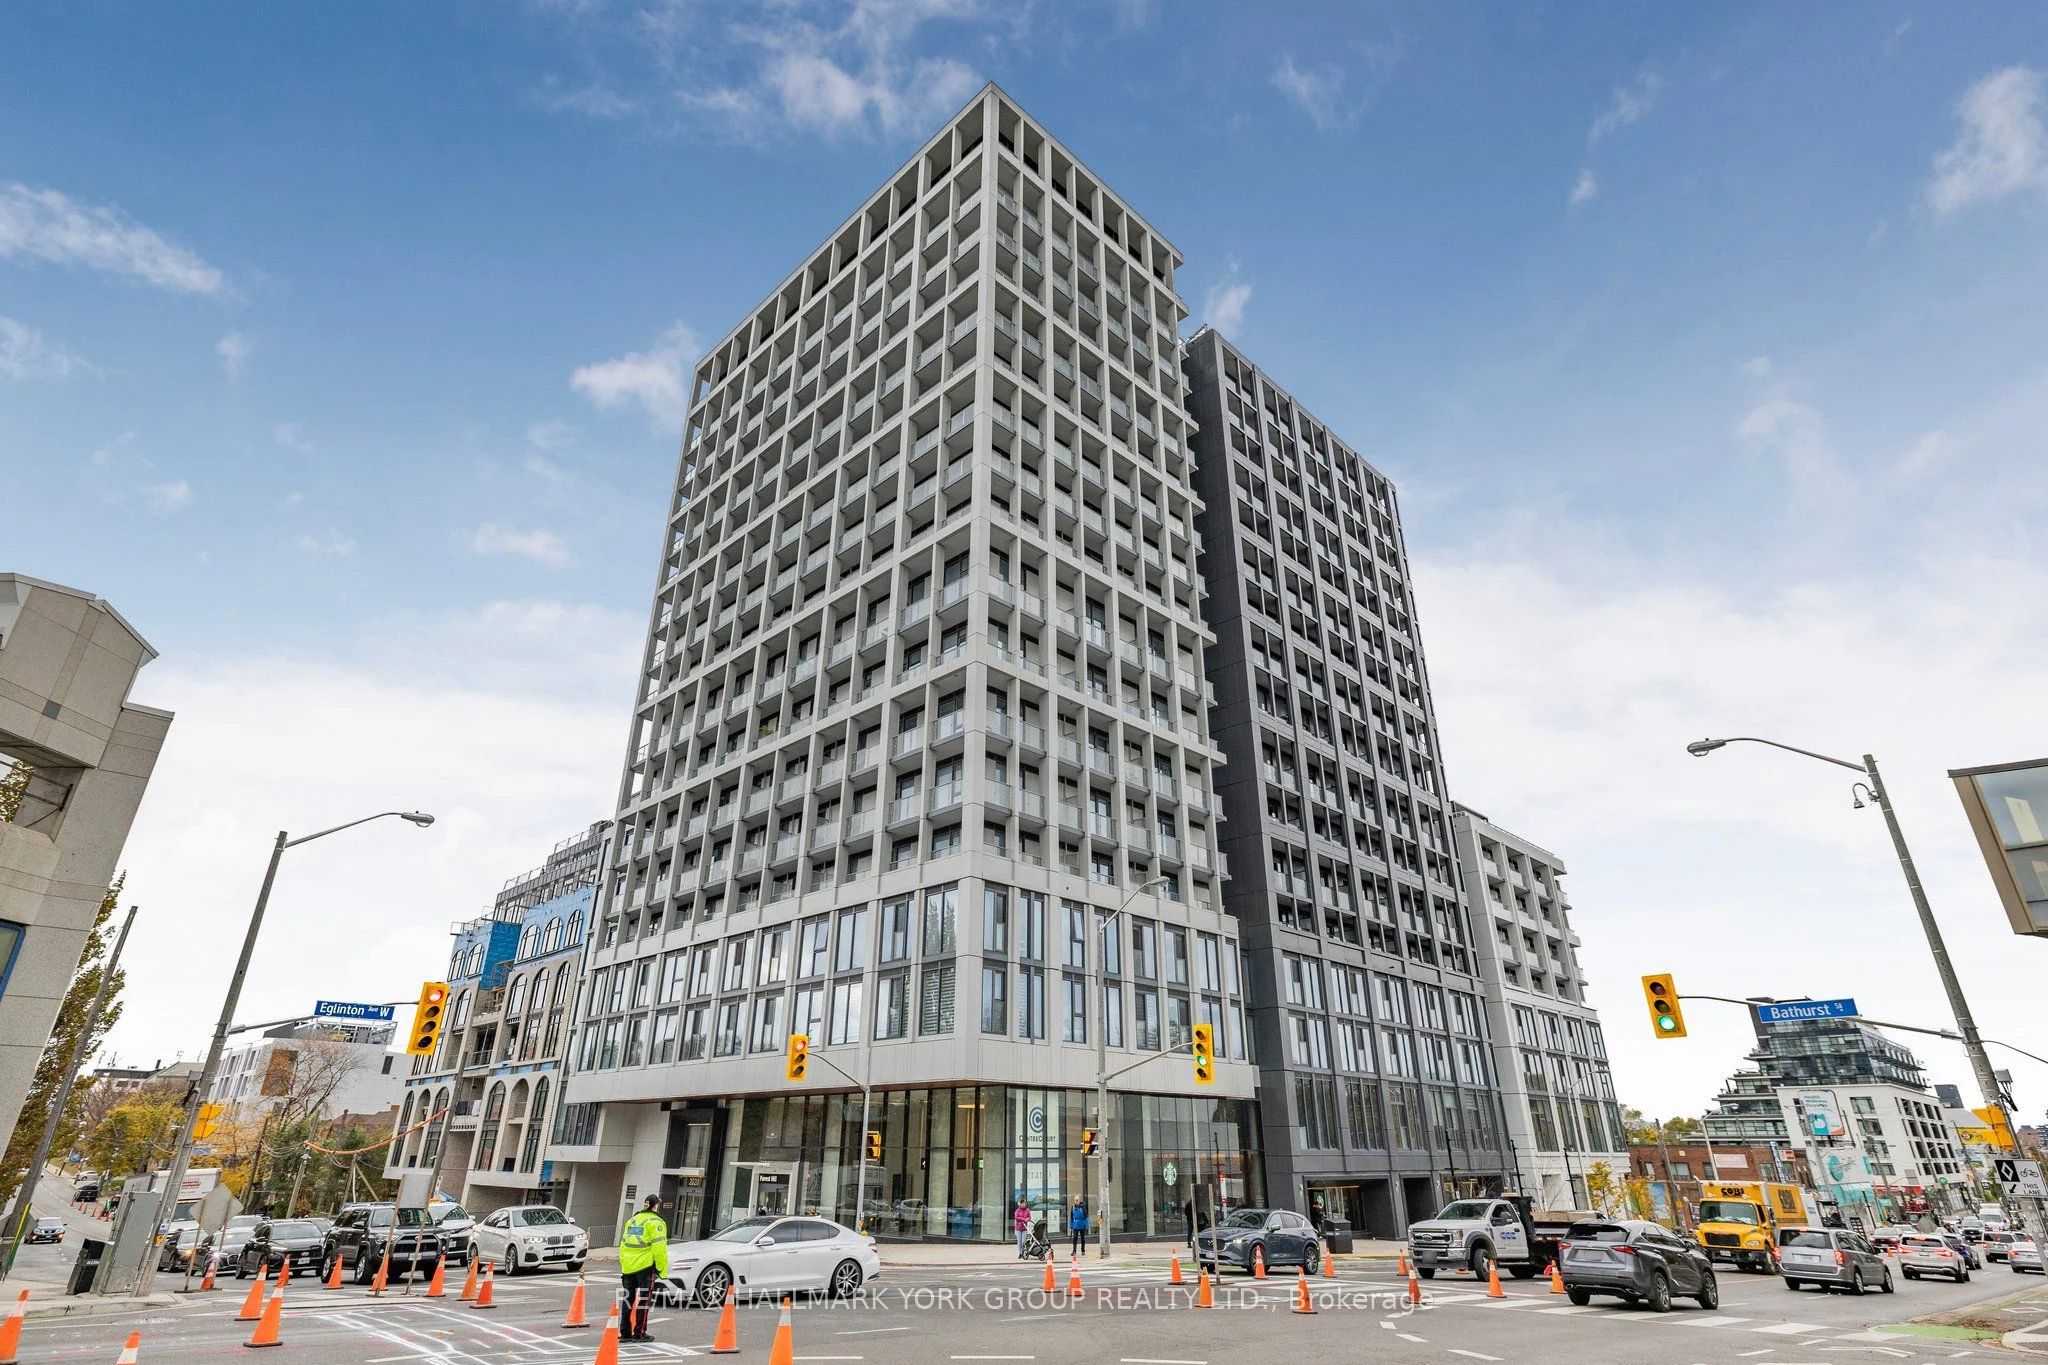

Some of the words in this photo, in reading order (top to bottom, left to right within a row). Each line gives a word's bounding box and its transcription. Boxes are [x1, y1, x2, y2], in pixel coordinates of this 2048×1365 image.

[319, 1002, 365, 1016] Eglinton
[368, 1005, 379, 1013] Ave
[379, 1006, 390, 1017] W
[1770, 1004, 1832, 1019] Bathurst
[1834, 1002, 1843, 1010] St
